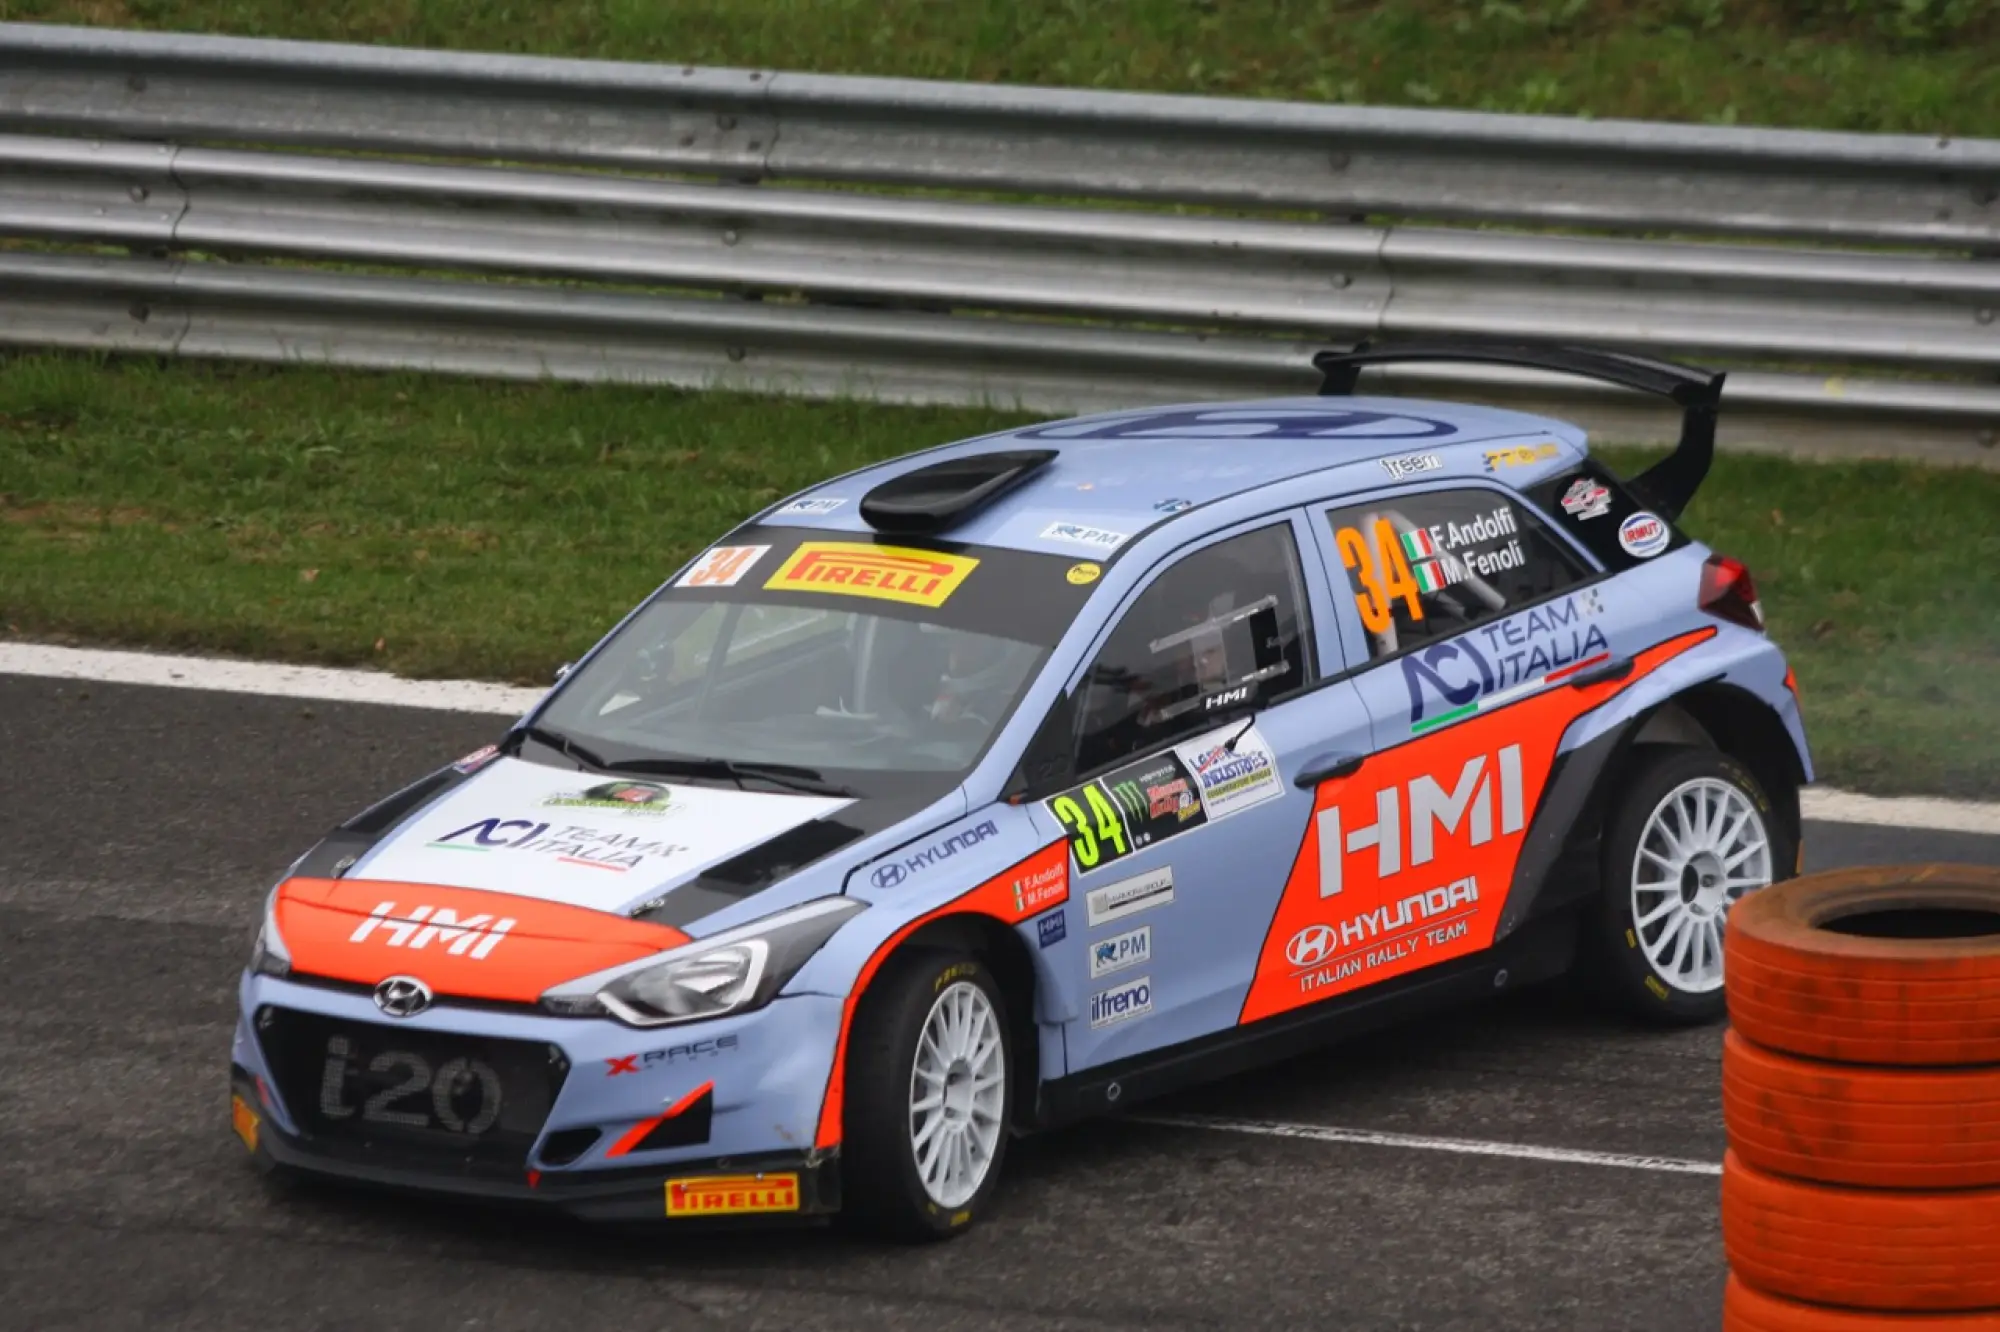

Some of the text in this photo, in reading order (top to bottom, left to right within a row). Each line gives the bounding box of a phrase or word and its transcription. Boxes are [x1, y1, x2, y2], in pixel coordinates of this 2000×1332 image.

[1431, 506, 1518, 552] F.Andolfi
[688, 547, 757, 586] 34
[785, 550, 955, 597] PIRELLI
[1334, 516, 1424, 634] 34
[1443, 542, 1526, 586] M.Fenoli
[1400, 596, 1580, 725] ACI TEAM
[1498, 623, 1610, 689] ITALIA
[1205, 687, 1248, 711] HMI
[435, 817, 652, 851] ACI TEAM
[1054, 783, 1126, 867] 34
[1316, 743, 1525, 899] HMI
[519, 838, 645, 868] ITALIA
[906, 819, 999, 873] HYUNDAI
[349, 901, 518, 961] HMI
[1340, 875, 1480, 947] HYUNDAI
[1119, 933, 1147, 959] PM
[1301, 919, 1468, 993] ITALIAN RALLY TEAM
[1091, 984, 1150, 1022] ilfreno
[604, 1053, 640, 1078] X
[643, 1034, 738, 1063] RACE
[319, 1035, 503, 1135] i20
[670, 1178, 796, 1211] PIRELLI
